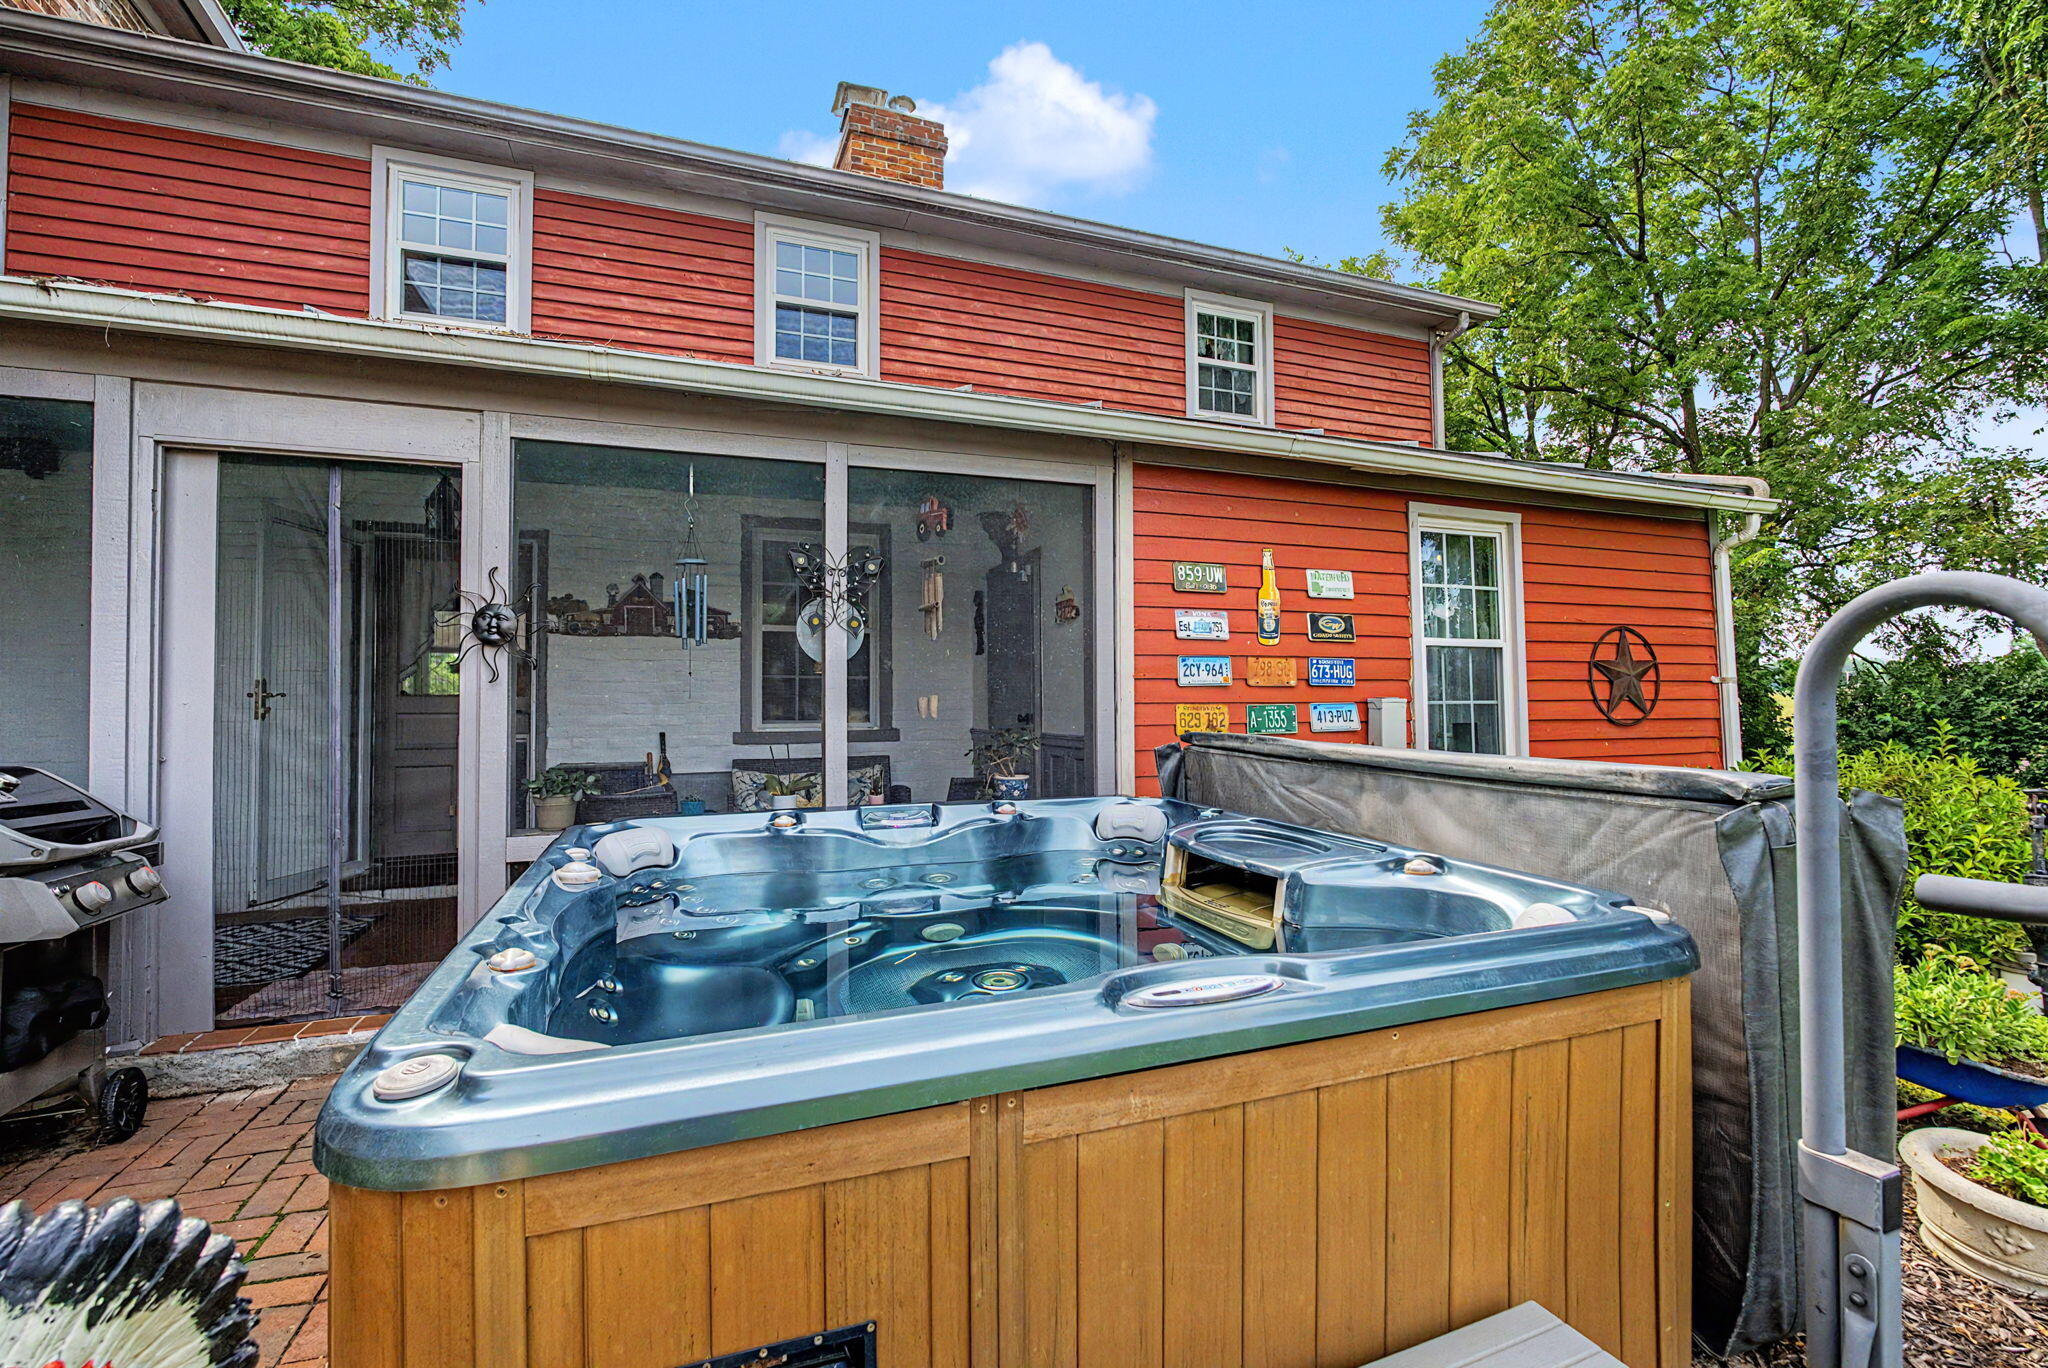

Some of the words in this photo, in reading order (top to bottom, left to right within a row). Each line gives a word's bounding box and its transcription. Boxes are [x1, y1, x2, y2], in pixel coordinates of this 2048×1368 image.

[1177, 565, 1223, 583] 859-UW
[1182, 662, 1224, 678] 2CY-964
[1311, 664, 1353, 679] 673-HUG
[1250, 710, 1288, 729] A-1355
[1317, 709, 1354, 724] 413-PUZ
